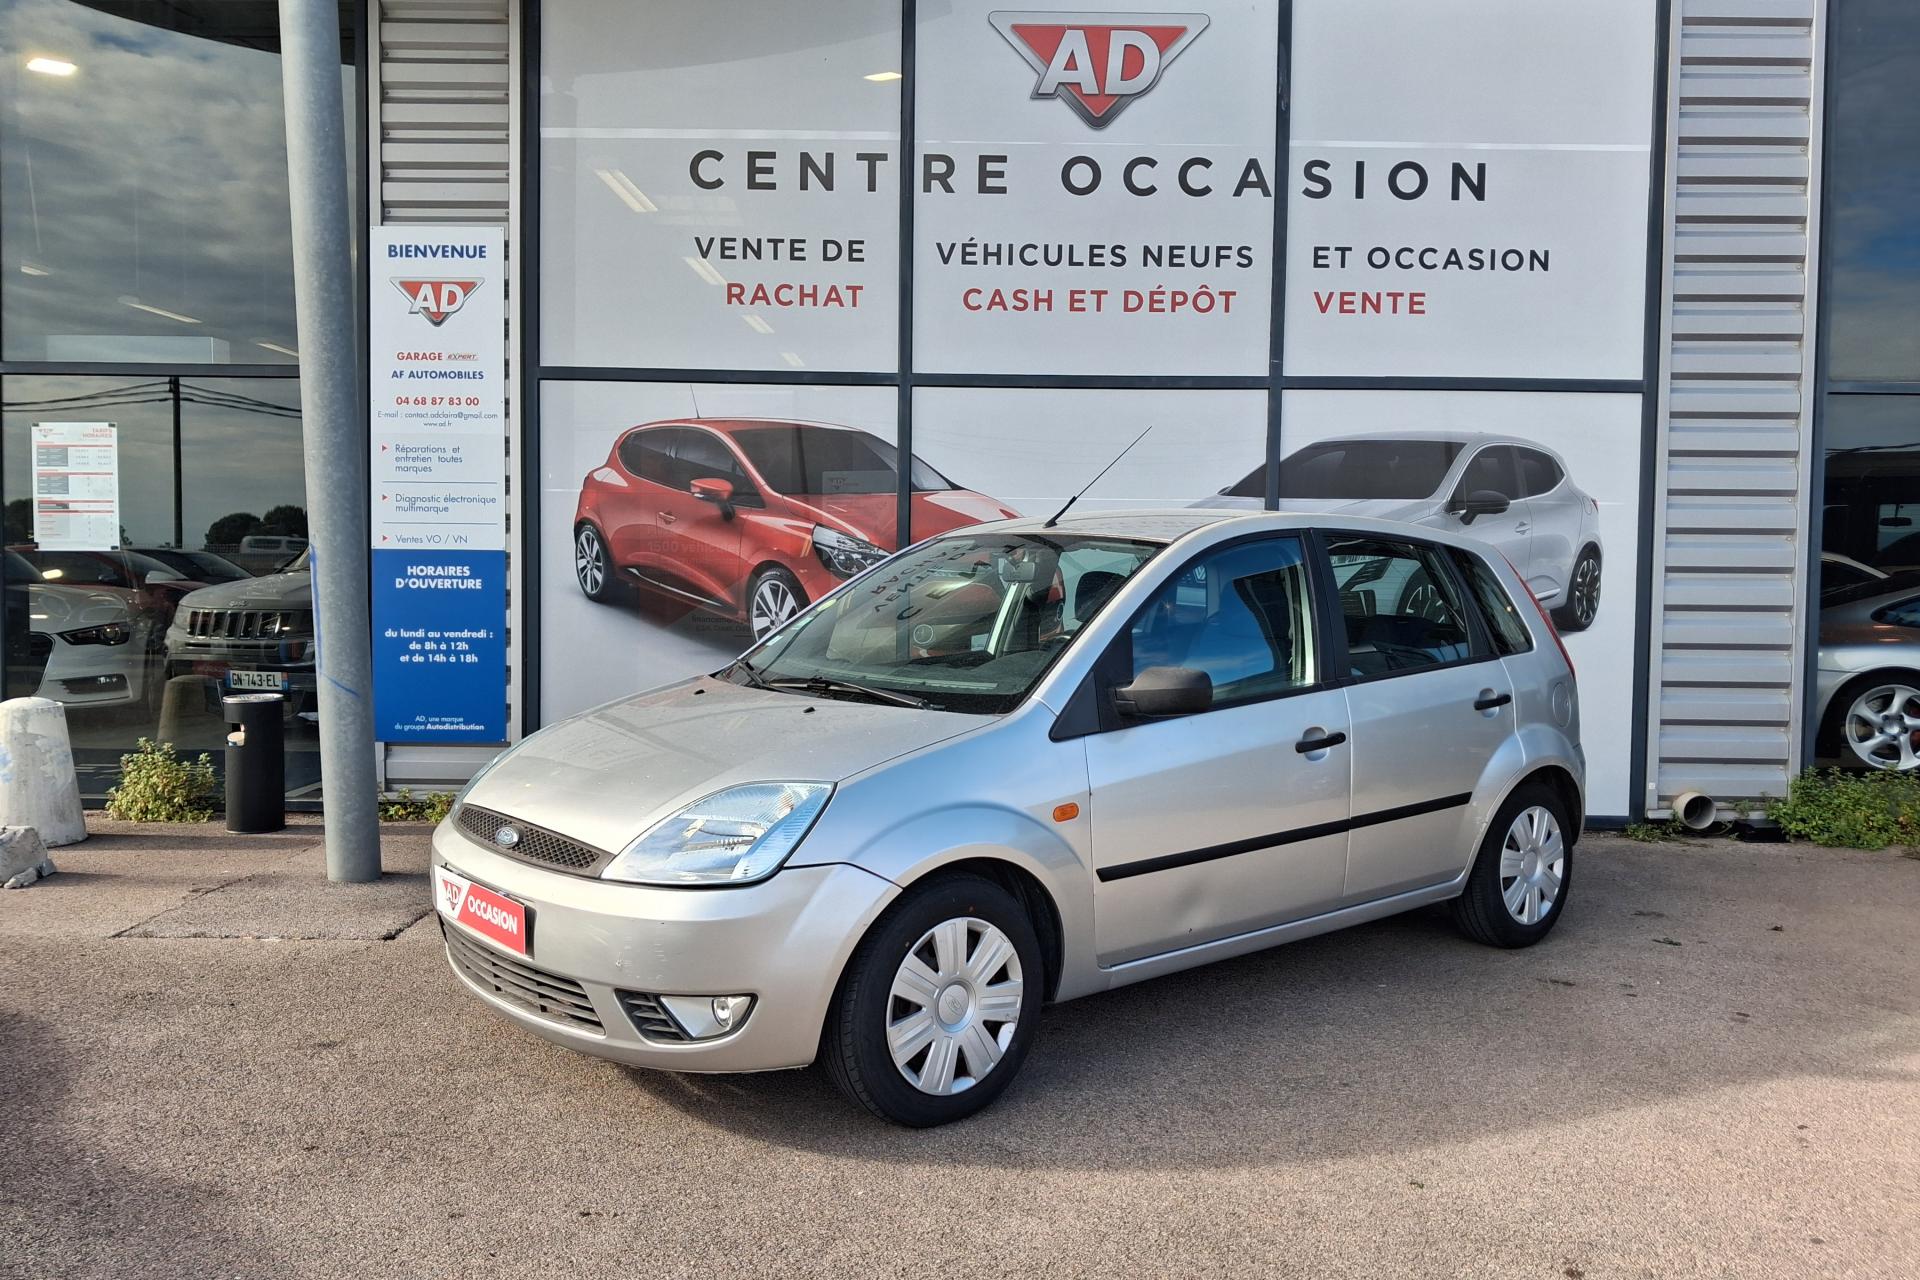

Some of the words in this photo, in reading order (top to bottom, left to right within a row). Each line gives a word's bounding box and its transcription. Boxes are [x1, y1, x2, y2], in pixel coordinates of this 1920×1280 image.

[1038, 29, 1161, 96] AD
[689, 149, 1008, 194] CENTRE
[1061, 155, 1487, 202] OCCASION
[387, 244, 487, 259] BIENVENUE
[694, 236, 808, 262] VENTE
[822, 239, 866, 263] DE
[936, 238, 1127, 268] VÉHICULES
[1142, 244, 1254, 269] NEUFS
[1313, 246, 1353, 269] ET
[1367, 246, 1550, 272] OCCASION
[410, 283, 465, 313] AD
[726, 282, 864, 309] RACHAT
[963, 287, 1054, 312] CASH
[1070, 289, 1109, 313] ET
[1123, 284, 1237, 314] DÉPÔT
[1314, 291, 1426, 315] VENTE
[397, 352, 443, 361] GARAGE
[391, 371, 405, 379] AF
[408, 371, 484, 380] AUTOMOBILES
[396, 396, 410, 405] 04
[413, 396, 427, 406] 68
[431, 397, 444, 406] 87
[448, 397, 462, 406] 83
[466, 397, 480, 406] 00
[377, 411, 399, 419] E-mail
[395, 444, 447, 455] Réparations
[395, 454, 432, 463] entretien
[438, 454, 463, 463] toutes
[395, 465, 433, 474] marques
[395, 494, 441, 505] Diagnostic
[444, 494, 497, 505] électronique
[395, 503, 449, 514] multimarque
[395, 534, 423, 544] Ventes
[425, 535, 442, 544] VO
[452, 535, 468, 544] VN
[407, 566, 470, 577] HORAIRES
[385, 629, 398, 638] du
[400, 629, 424, 638] lundi
[428, 630, 441, 639] au
[444, 629, 487, 639] vendredi
[409, 641, 421, 650] de
[425, 641, 437, 650] 8h
[451, 641, 469, 650] 12h
[400, 654, 410, 662] et
[412, 653, 424, 663] de
[428, 653, 446, 663] 14h
[460, 654, 478, 663] 18h
[232, 673, 280, 687] GN-743-EL
[426, 723, 485, 731] Autodistribution
[445, 883, 460, 904] AD
[467, 895, 518, 935] OCCASION
